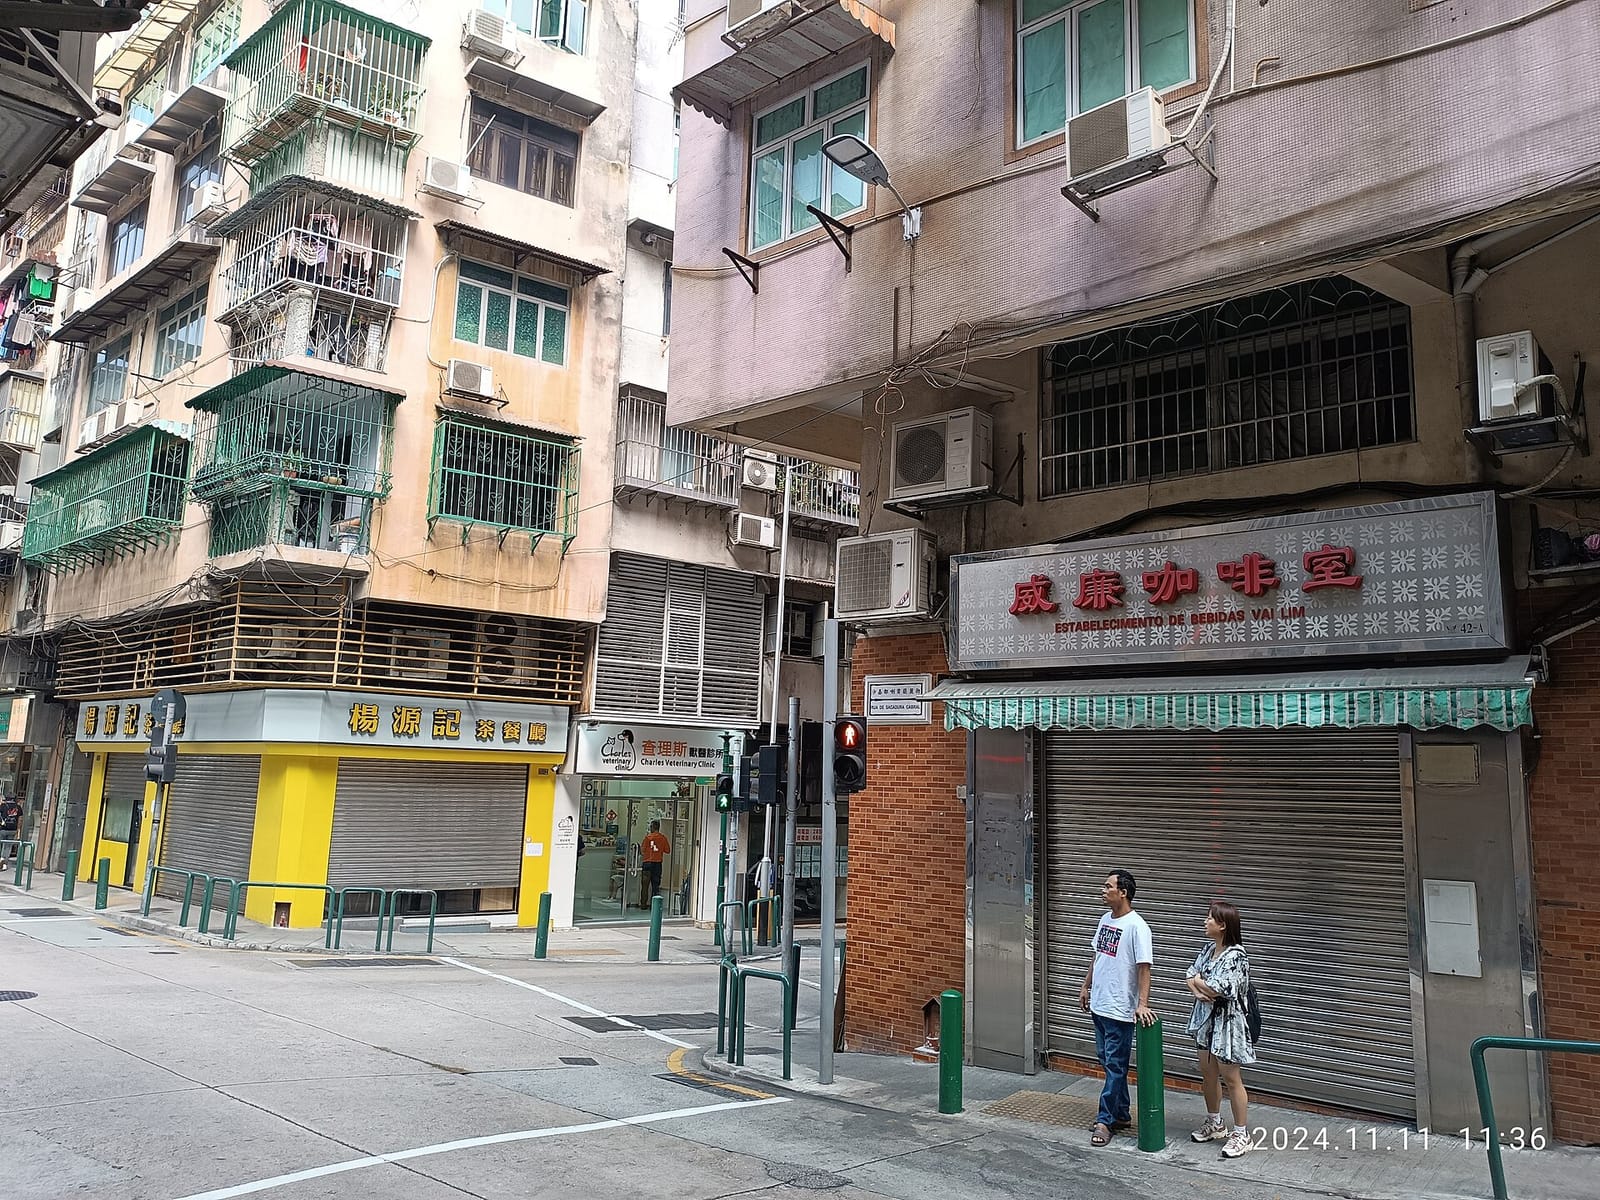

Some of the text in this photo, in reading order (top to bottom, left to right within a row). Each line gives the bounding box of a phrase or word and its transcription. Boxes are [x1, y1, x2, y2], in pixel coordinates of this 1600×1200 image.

[1009, 544, 1362, 615] 威廉咖啡室
[1055, 607, 1306, 633] ESTABELECIMENTO DE BEBIDAS VAI LIM
[640, 758, 715, 769] Charles Veterinary Clinic
